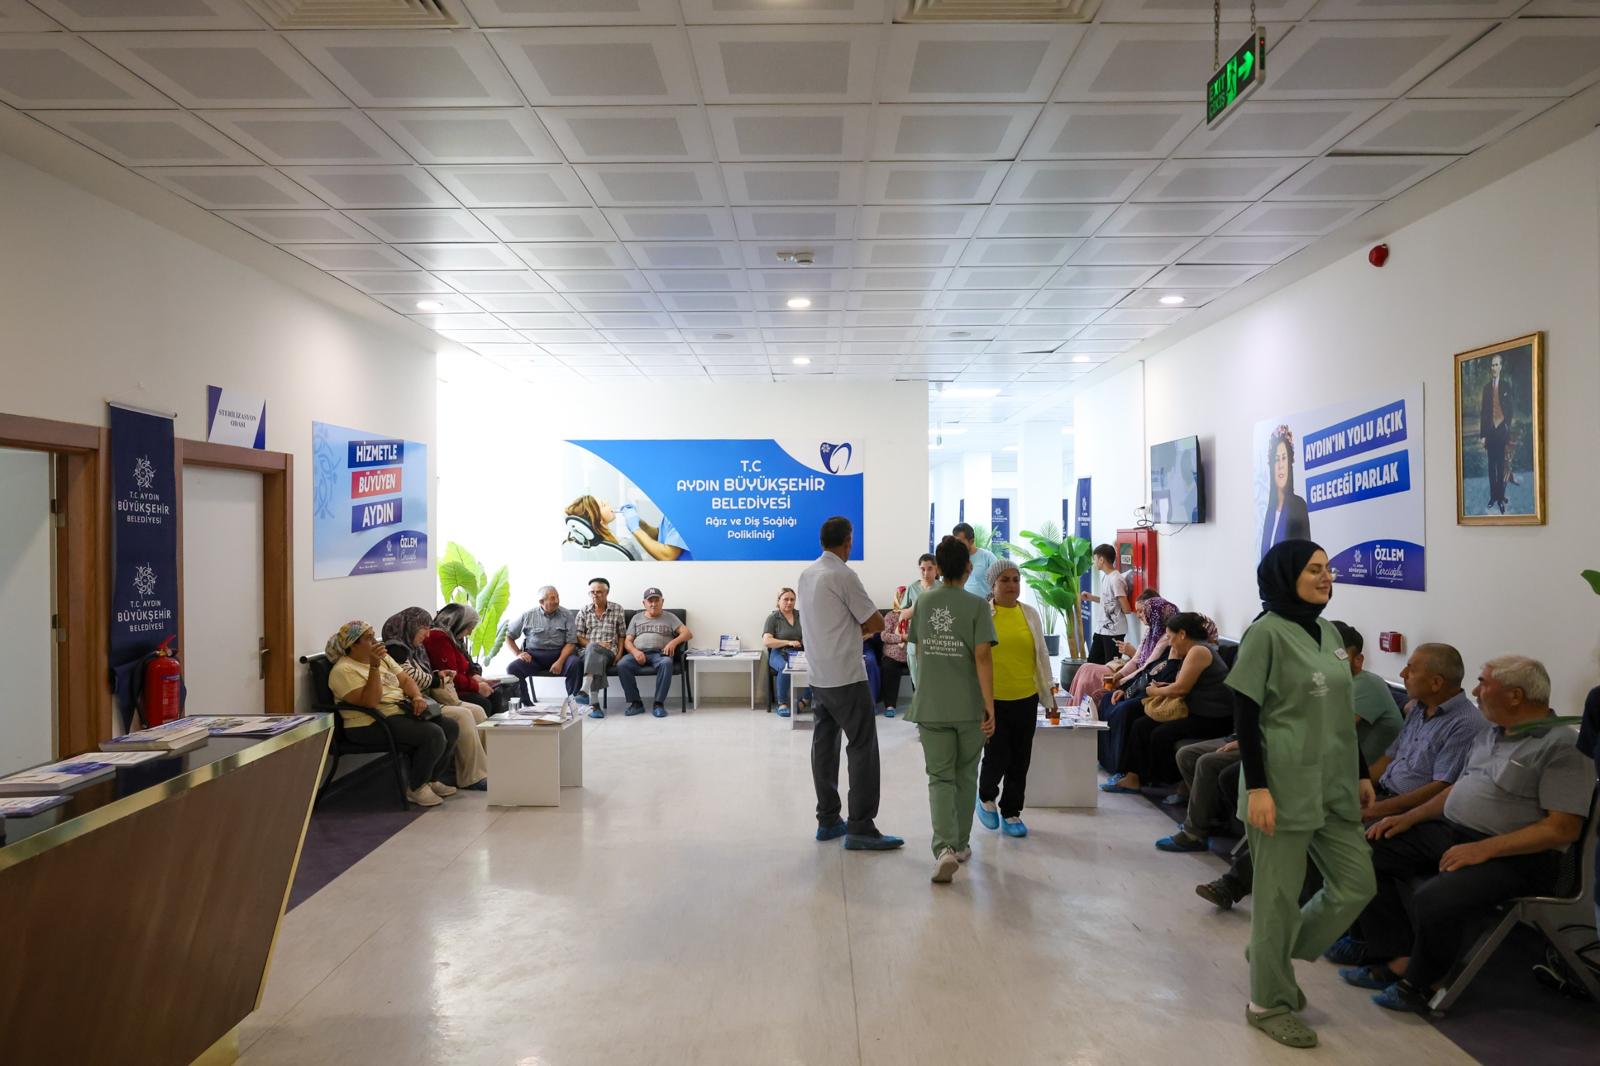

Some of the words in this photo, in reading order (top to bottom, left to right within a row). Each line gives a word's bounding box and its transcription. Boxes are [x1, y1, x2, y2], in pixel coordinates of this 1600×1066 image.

[1209, 74, 1226, 97] EXIT
[1305, 431, 1345, 462] AYDIN'IN
[1347, 421, 1374, 446] YOLU
[1376, 409, 1403, 438] AÇIK
[356, 440, 397, 462] HİZMETLE
[740, 459, 762, 473] T.C
[358, 471, 397, 493] BÜYÜYEN
[676, 478, 720, 492] AYDIN
[723, 474, 826, 495] BÜYÜKŞEHİR
[1311, 471, 1353, 503] GELECEĞİ
[1355, 462, 1398, 492] PARLAK
[140, 493, 160, 501] AYDIN
[711, 494, 792, 510] BELEDİYESİ
[117, 499, 170, 516] BÜYÜKŞEHİR
[362, 502, 394, 529] AYDIN
[127, 514, 163, 525] BELEDİYESİ
[704, 516, 728, 528] Ağız
[730, 518, 742, 526] ve
[744, 516, 761, 528] Diş
[762, 516, 798, 528] Sağlığı
[400, 534, 418, 549] ÖZLEM
[727, 529, 776, 542] Polikliniği
[1374, 544, 1405, 562] ÖZLEM
[143, 600, 161, 608] AYDIN
[117, 607, 172, 623] BÜYÜKŞEHİR
[129, 622, 165, 633] BELEDİYESİ
